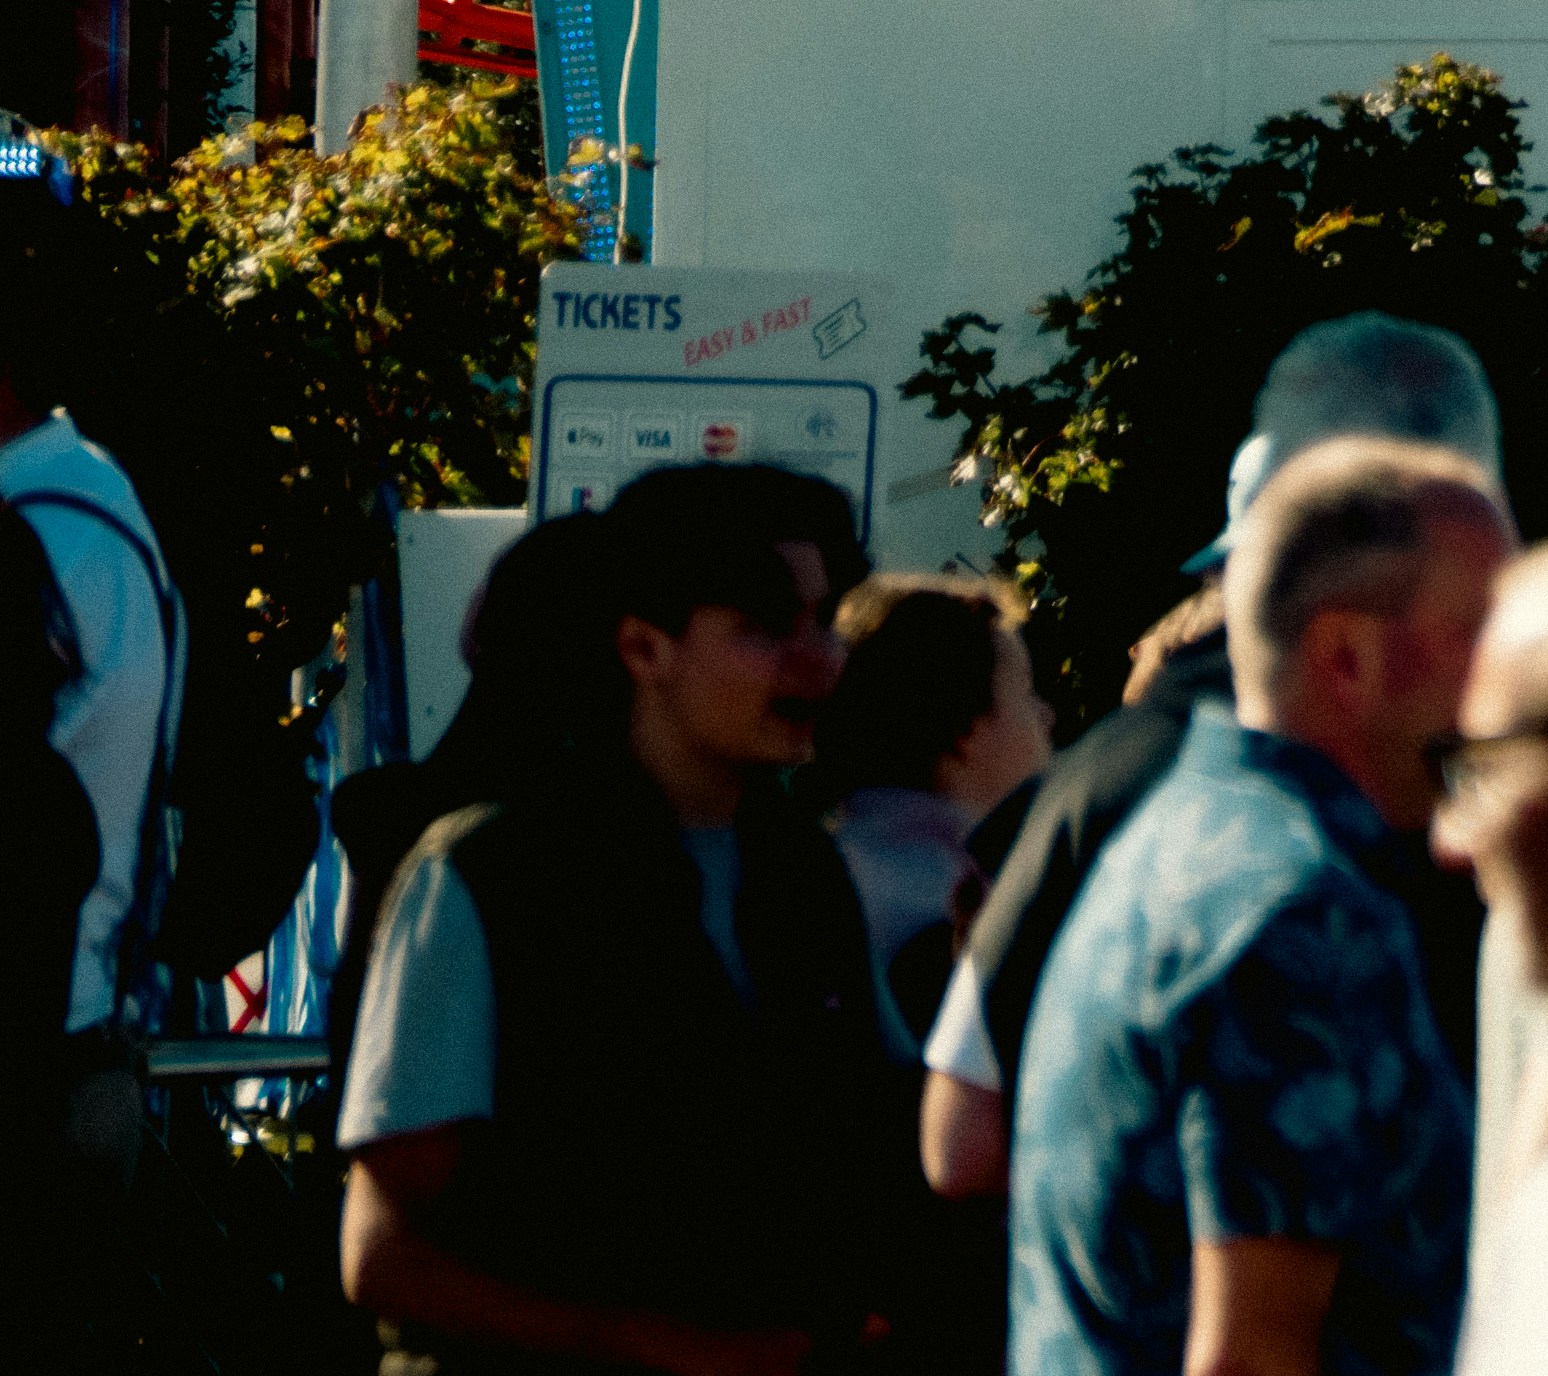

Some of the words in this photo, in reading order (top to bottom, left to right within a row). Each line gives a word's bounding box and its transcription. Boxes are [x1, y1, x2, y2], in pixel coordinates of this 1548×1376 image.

[553, 291, 682, 331] TICKETS
[684, 330, 735, 367] EASY
[740, 319, 758, 345] &
[762, 296, 813, 333] FAST
[637, 429, 671, 448] VISA
